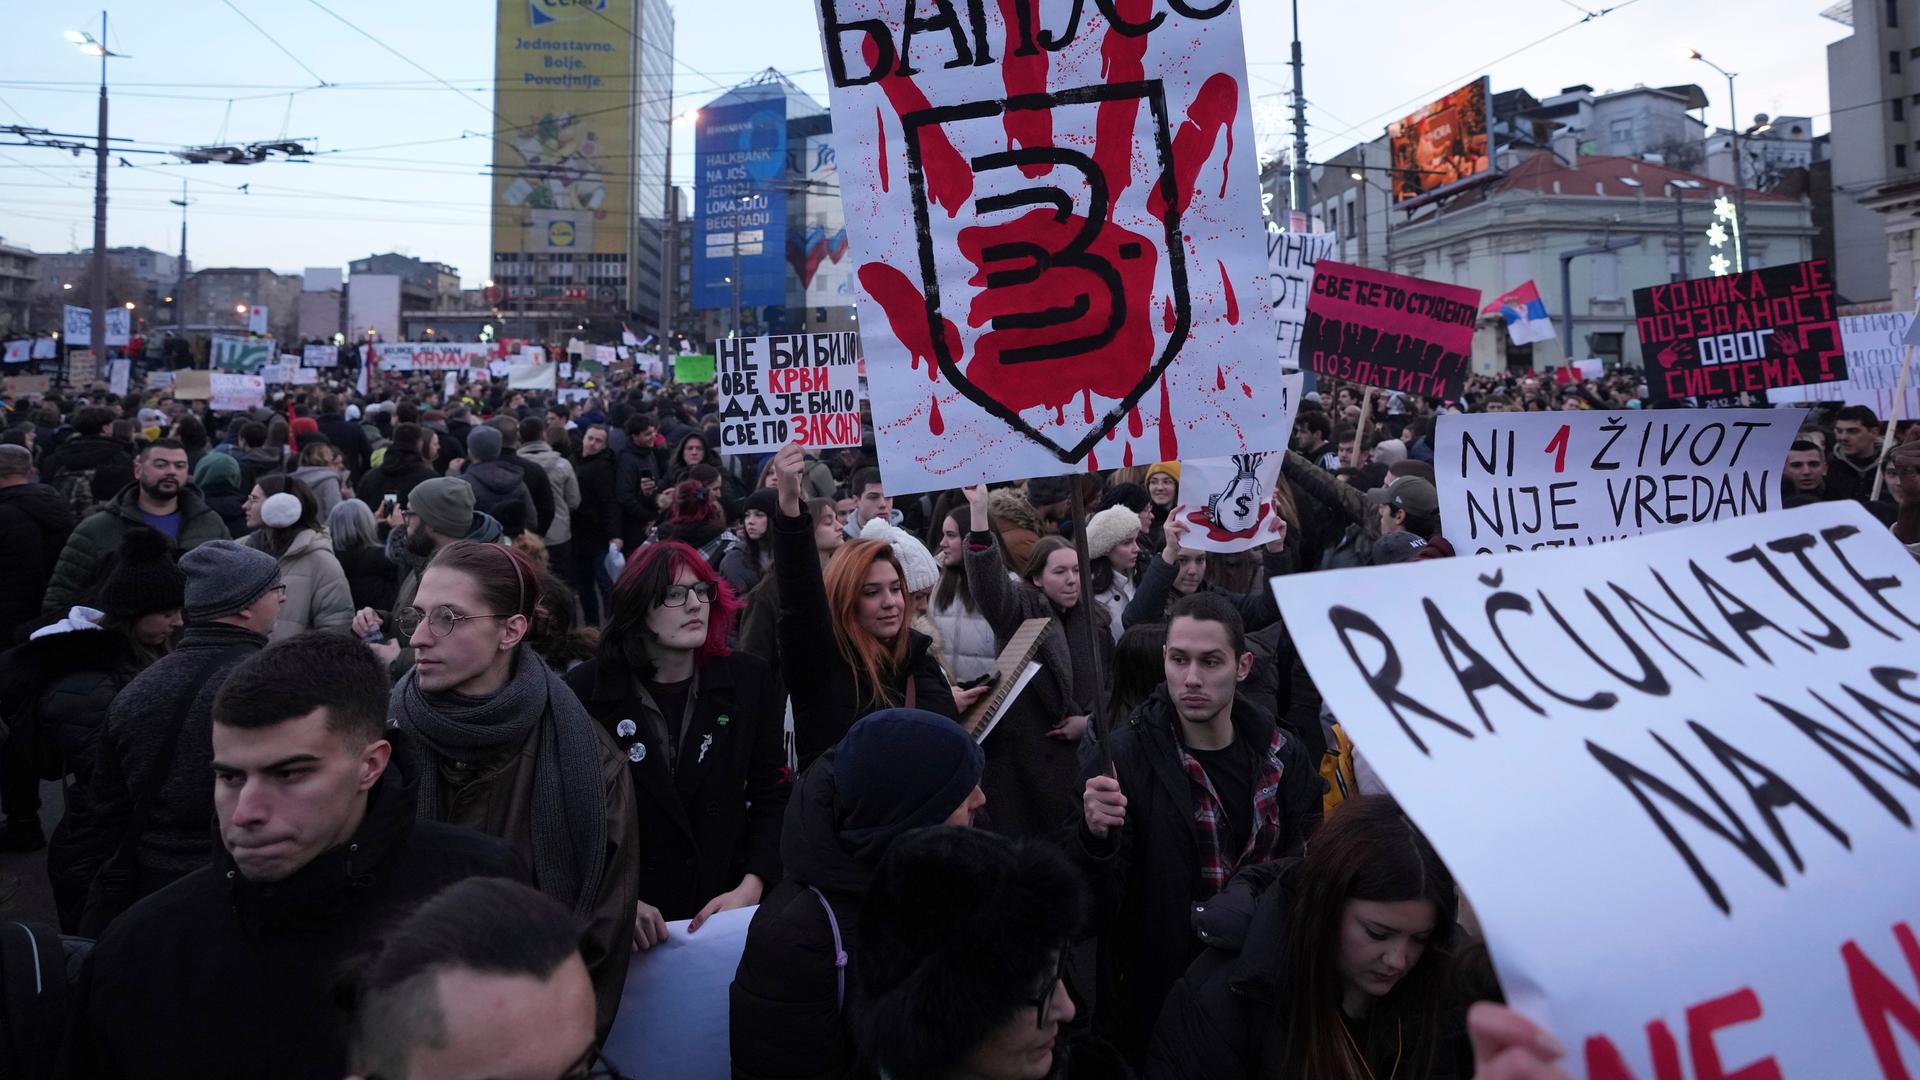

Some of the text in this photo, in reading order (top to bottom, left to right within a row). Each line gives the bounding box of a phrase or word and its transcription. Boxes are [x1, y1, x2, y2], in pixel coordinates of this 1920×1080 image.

[515, 38, 616, 51] Jednostavno.
[544, 56, 586, 69] Bolje.
[524, 73, 605, 87] Povoljnije.
[706, 148, 771, 167] HALKBANK
[706, 166, 747, 182] NA JOŠ
[706, 213, 770, 230] BEOGRADU
[1313, 273, 1353, 301] СВЕ
[1384, 285, 1406, 311] ТО
[1406, 291, 1479, 329] СТУДЕНТИ
[1651, 260, 1831, 313] КОЛИКА ЈЕ
[1637, 290, 1833, 345] ПОУЗДАНОСТ
[720, 332, 857, 373] НЕ БИ БИЛО
[1698, 328, 1775, 366] ОВОГ
[721, 367, 828, 396] ОВЕ КРВИ
[1665, 357, 1805, 399] СИСТЕМА
[720, 389, 854, 422] ДА ЈЕ БИЛО
[722, 412, 861, 446] СВЕ ПО ЗАКОНУ
[1461, 416, 1773, 478] NI 1 ŽIVOT
[1467, 470, 1769, 540] NIJE VREDAN
[1329, 524, 1920, 757] RAČUNAJTE
[1585, 720, 1853, 916] NA
